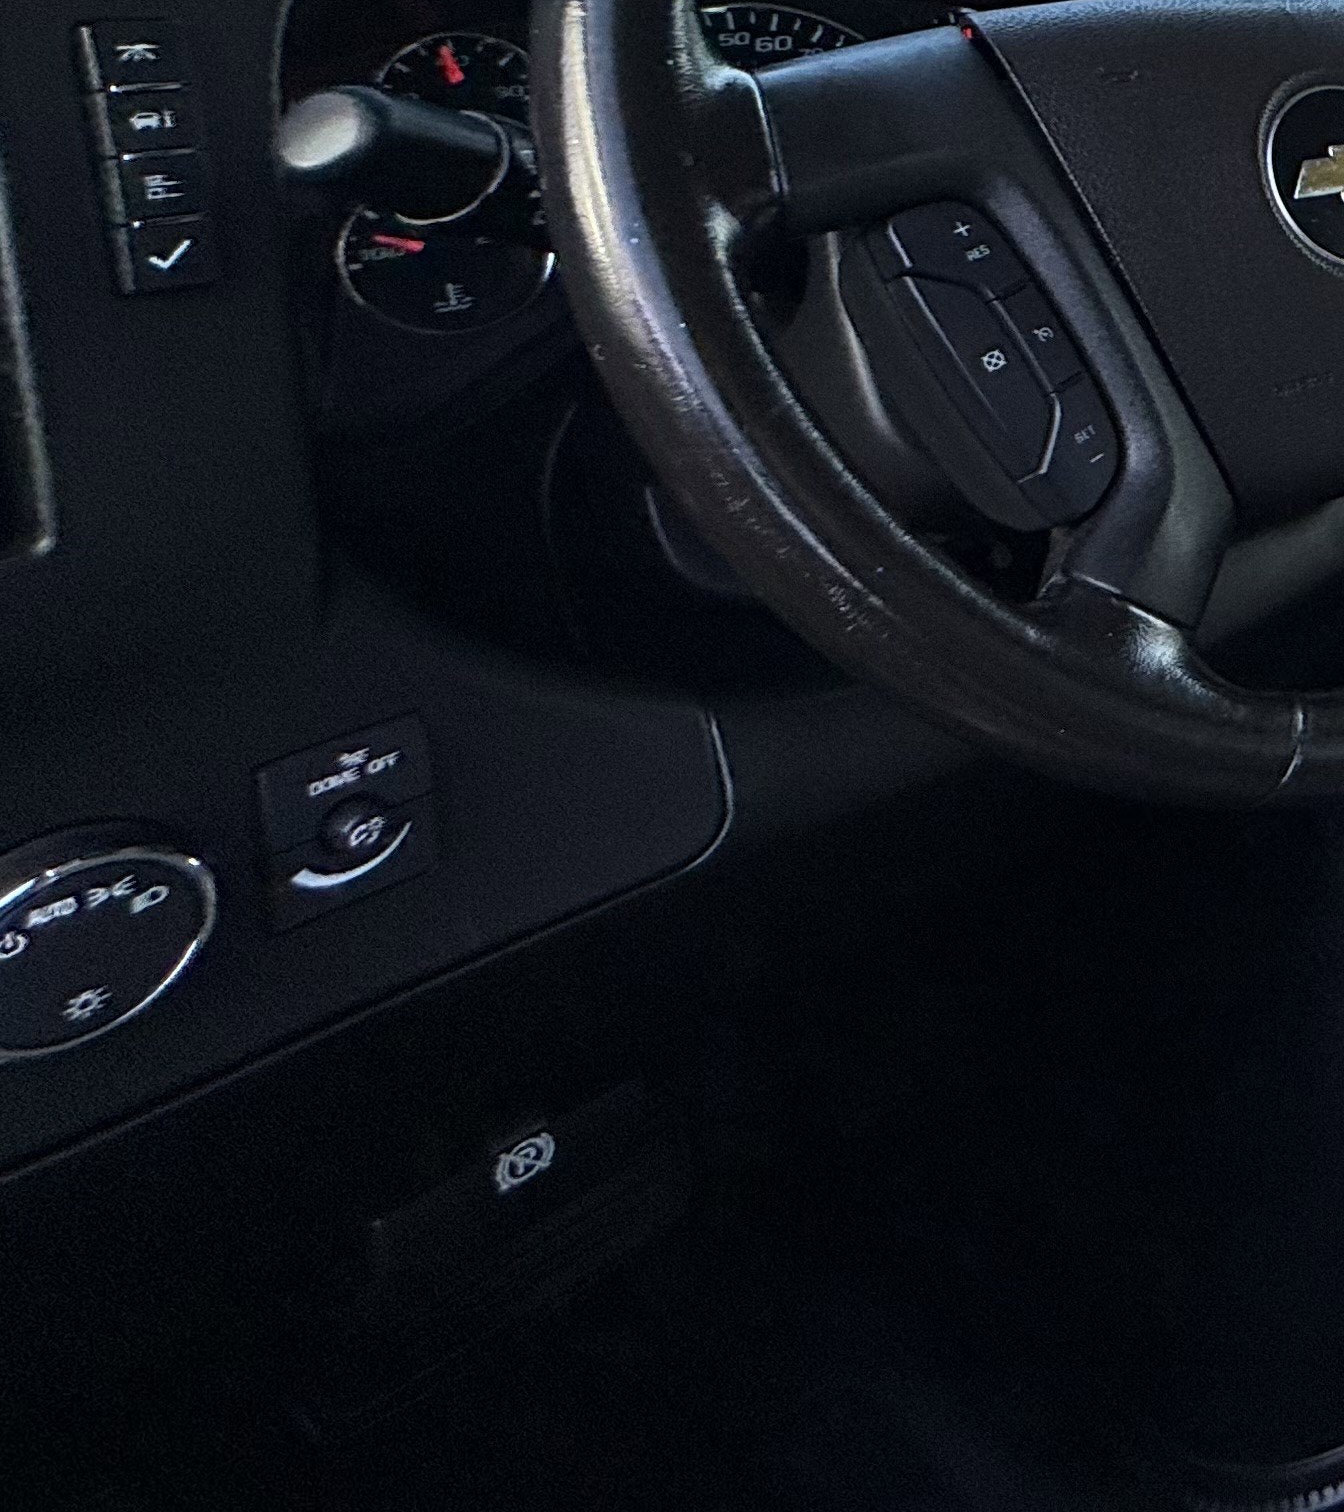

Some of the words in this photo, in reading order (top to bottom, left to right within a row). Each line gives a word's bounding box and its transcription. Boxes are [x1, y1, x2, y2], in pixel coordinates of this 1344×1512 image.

[718, 31, 751, 46] 50
[754, 35, 793, 52] 60
[966, 244, 991, 261] RES
[1073, 424, 1096, 445] SET
